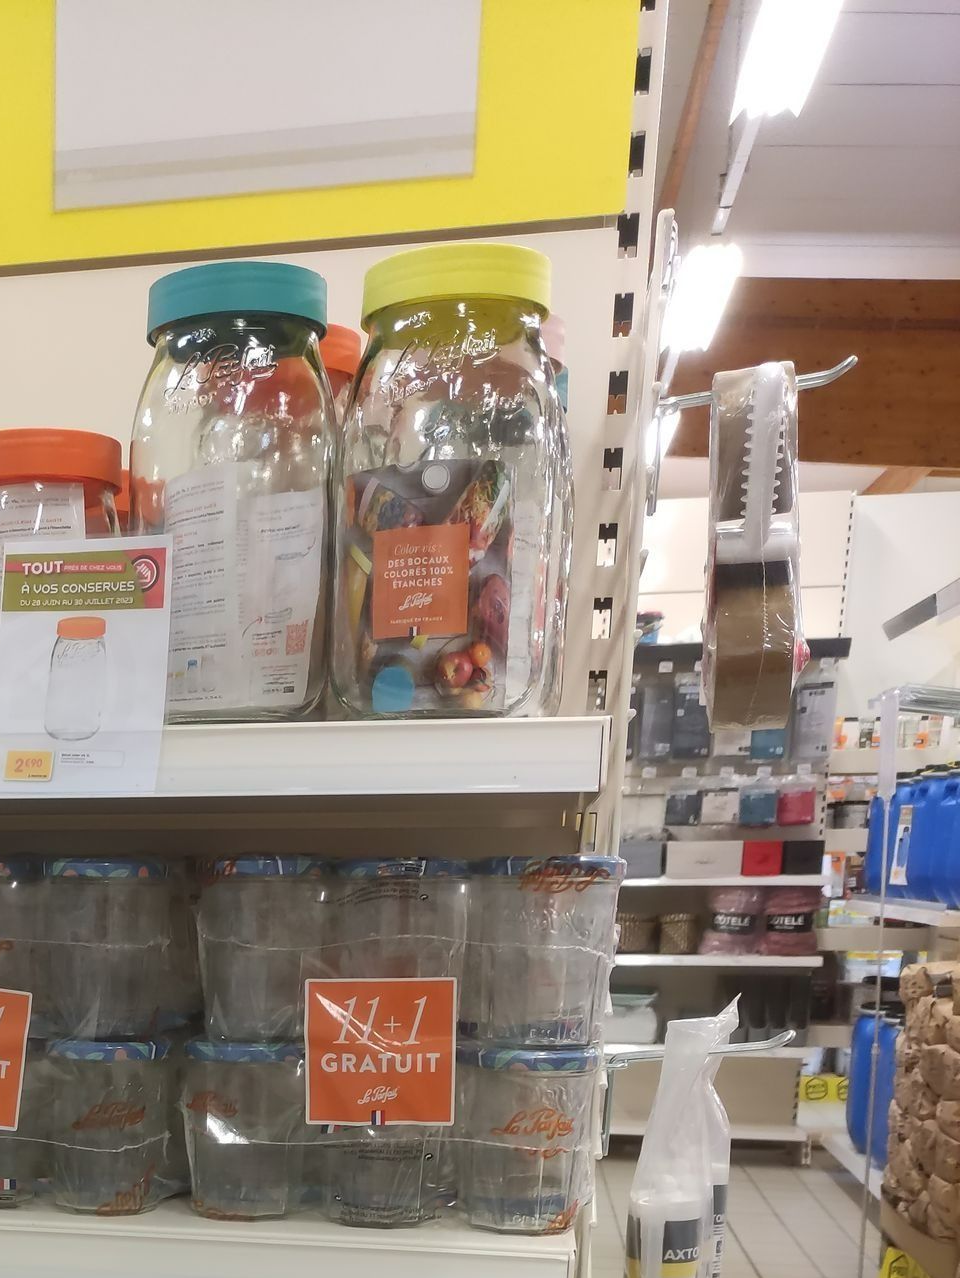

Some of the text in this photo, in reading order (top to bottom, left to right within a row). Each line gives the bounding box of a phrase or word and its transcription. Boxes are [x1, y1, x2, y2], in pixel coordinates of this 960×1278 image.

[395, 544, 420, 556] Color
[22, 561, 64, 576] TOUT
[388, 556, 449, 569] DES BOCAUX
[430, 566, 454, 576] 100%
[21, 581, 135, 594] À VOS CONSERVES
[393, 578, 443, 589] ÉTANCHES
[20, 599, 30, 607] DU
[85, 597, 114, 606] JUILLET
[332, 996, 428, 1046] 11+1
[320, 1052, 440, 1073] GRATUIT
[357, 1086, 399, 1105] Le Parfait
